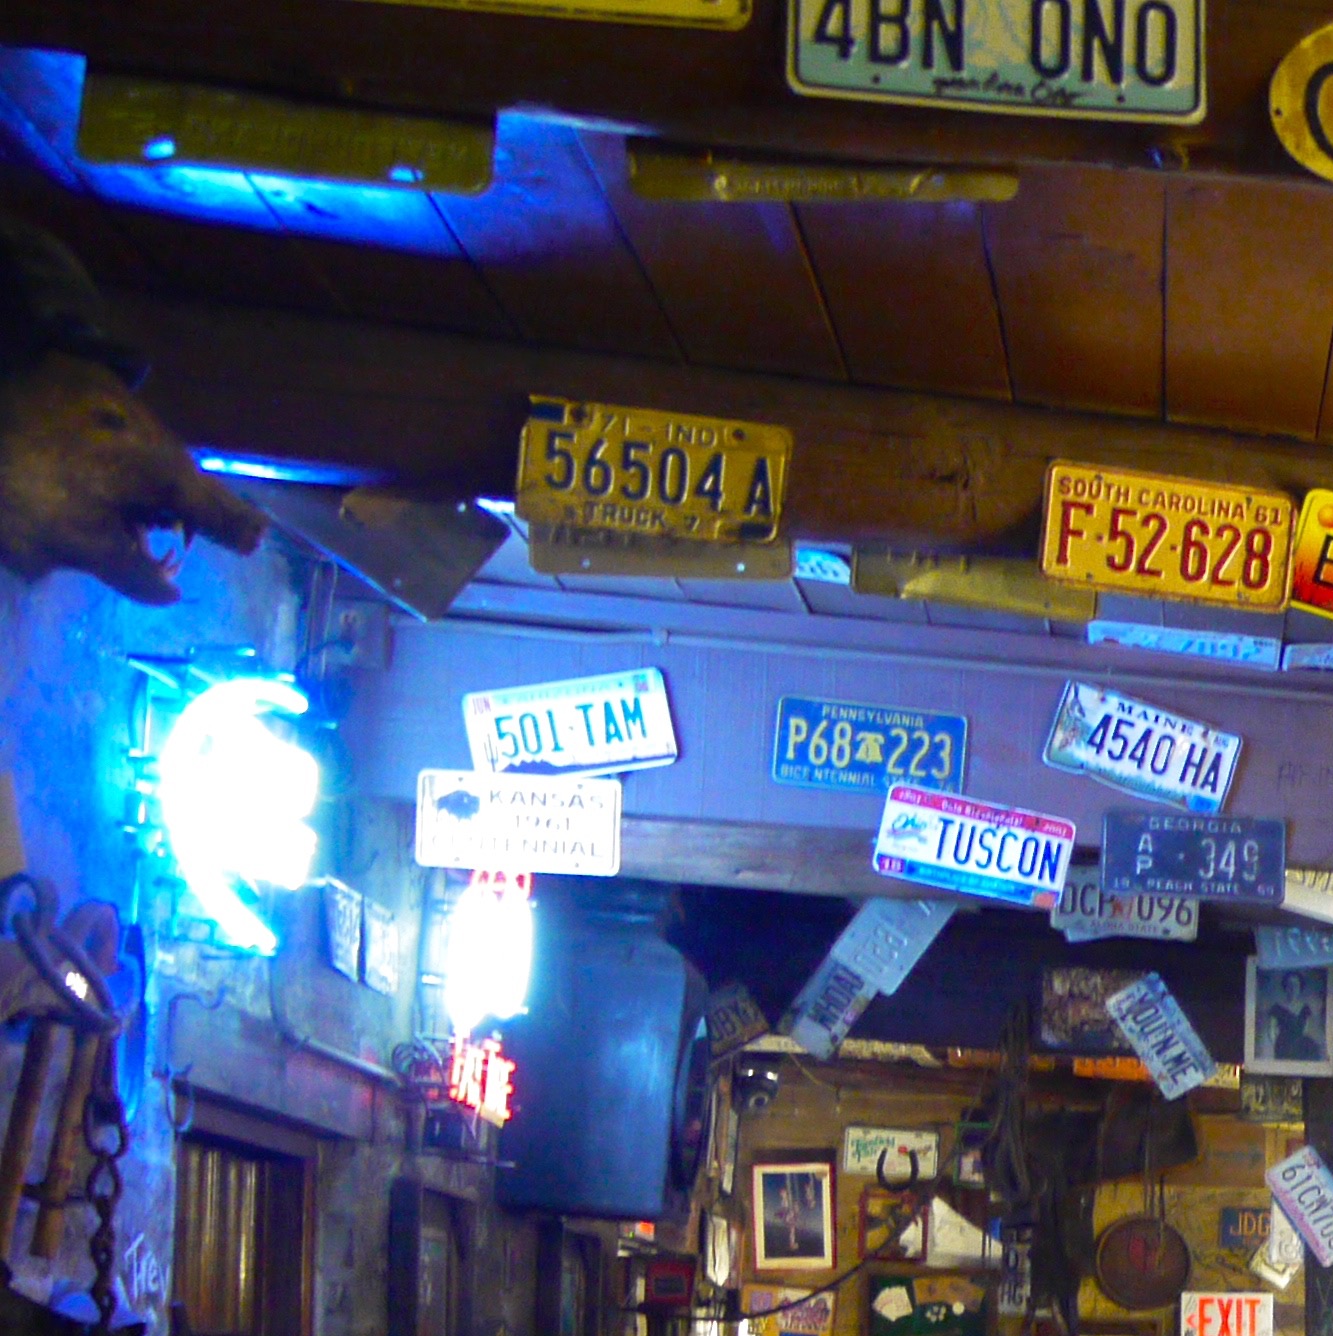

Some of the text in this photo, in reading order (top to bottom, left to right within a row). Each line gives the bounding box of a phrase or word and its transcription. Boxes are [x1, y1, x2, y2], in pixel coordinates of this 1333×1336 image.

[543, 430, 774, 518] 56504 A
[1057, 475, 1133, 507] SOUTH
[1136, 486, 1247, 523] CAROLINA
[821, 704, 925, 729] PENNSYLVANIA
[1117, 700, 1195, 737] MAINE
[785, 716, 952, 781] P68 223
[1086, 711, 1225, 795] 4540 HA
[488, 789, 606, 810] KANSAS
[514, 814, 572, 832] 1961
[1149, 817, 1244, 836] GEORGIA
[935, 816, 1065, 884] TUSCON
[1146, 878, 1195, 894] PEACH
[1200, 882, 1242, 896] STATE
[1136, 893, 1195, 928] 096
